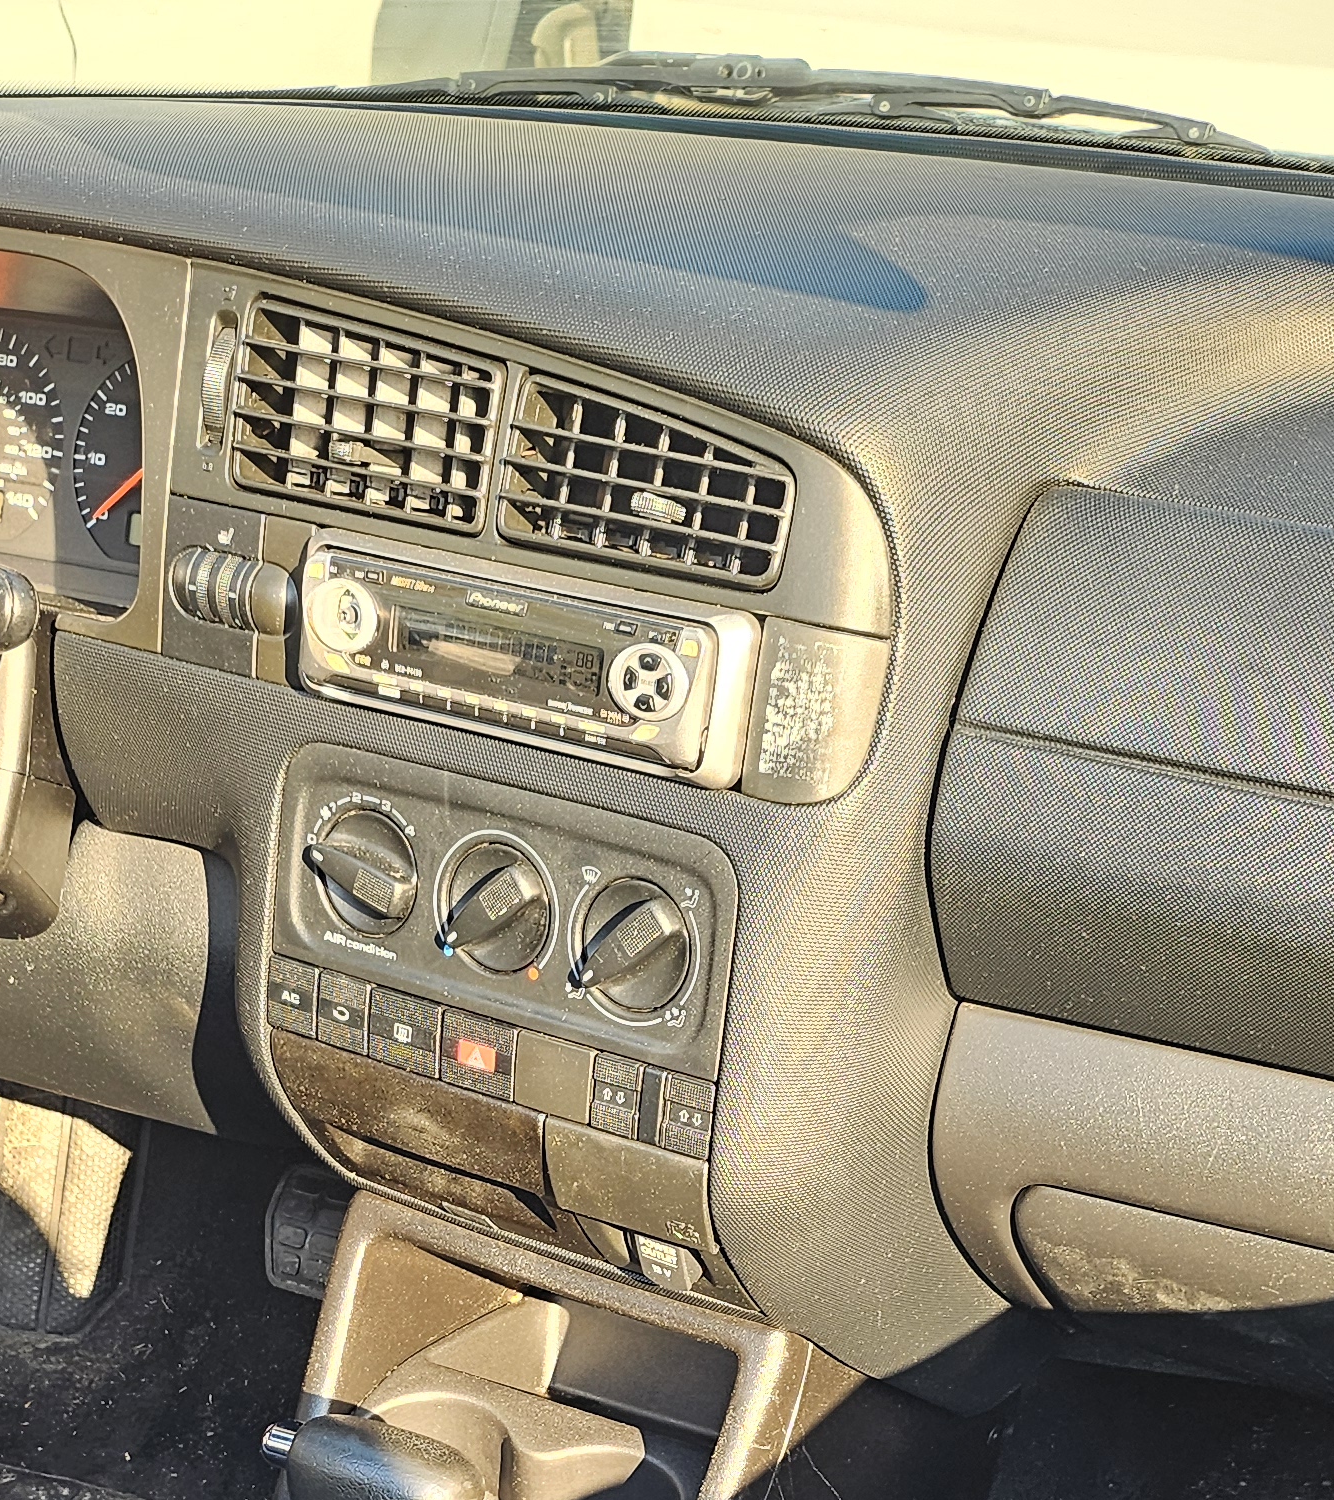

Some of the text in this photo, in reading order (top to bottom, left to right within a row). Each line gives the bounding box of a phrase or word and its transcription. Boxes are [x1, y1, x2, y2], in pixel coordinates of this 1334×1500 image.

[18, 390, 47, 406] 100
[105, 402, 127, 417] 20
[23, 443, 53, 459] 120
[87, 452, 106, 466] 10
[469, 591, 524, 613] Pioneer
[351, 791, 362, 803] 2
[381, 799, 392, 812] 3
[404, 824, 416, 837] 4
[323, 930, 397, 962] AIR condition
